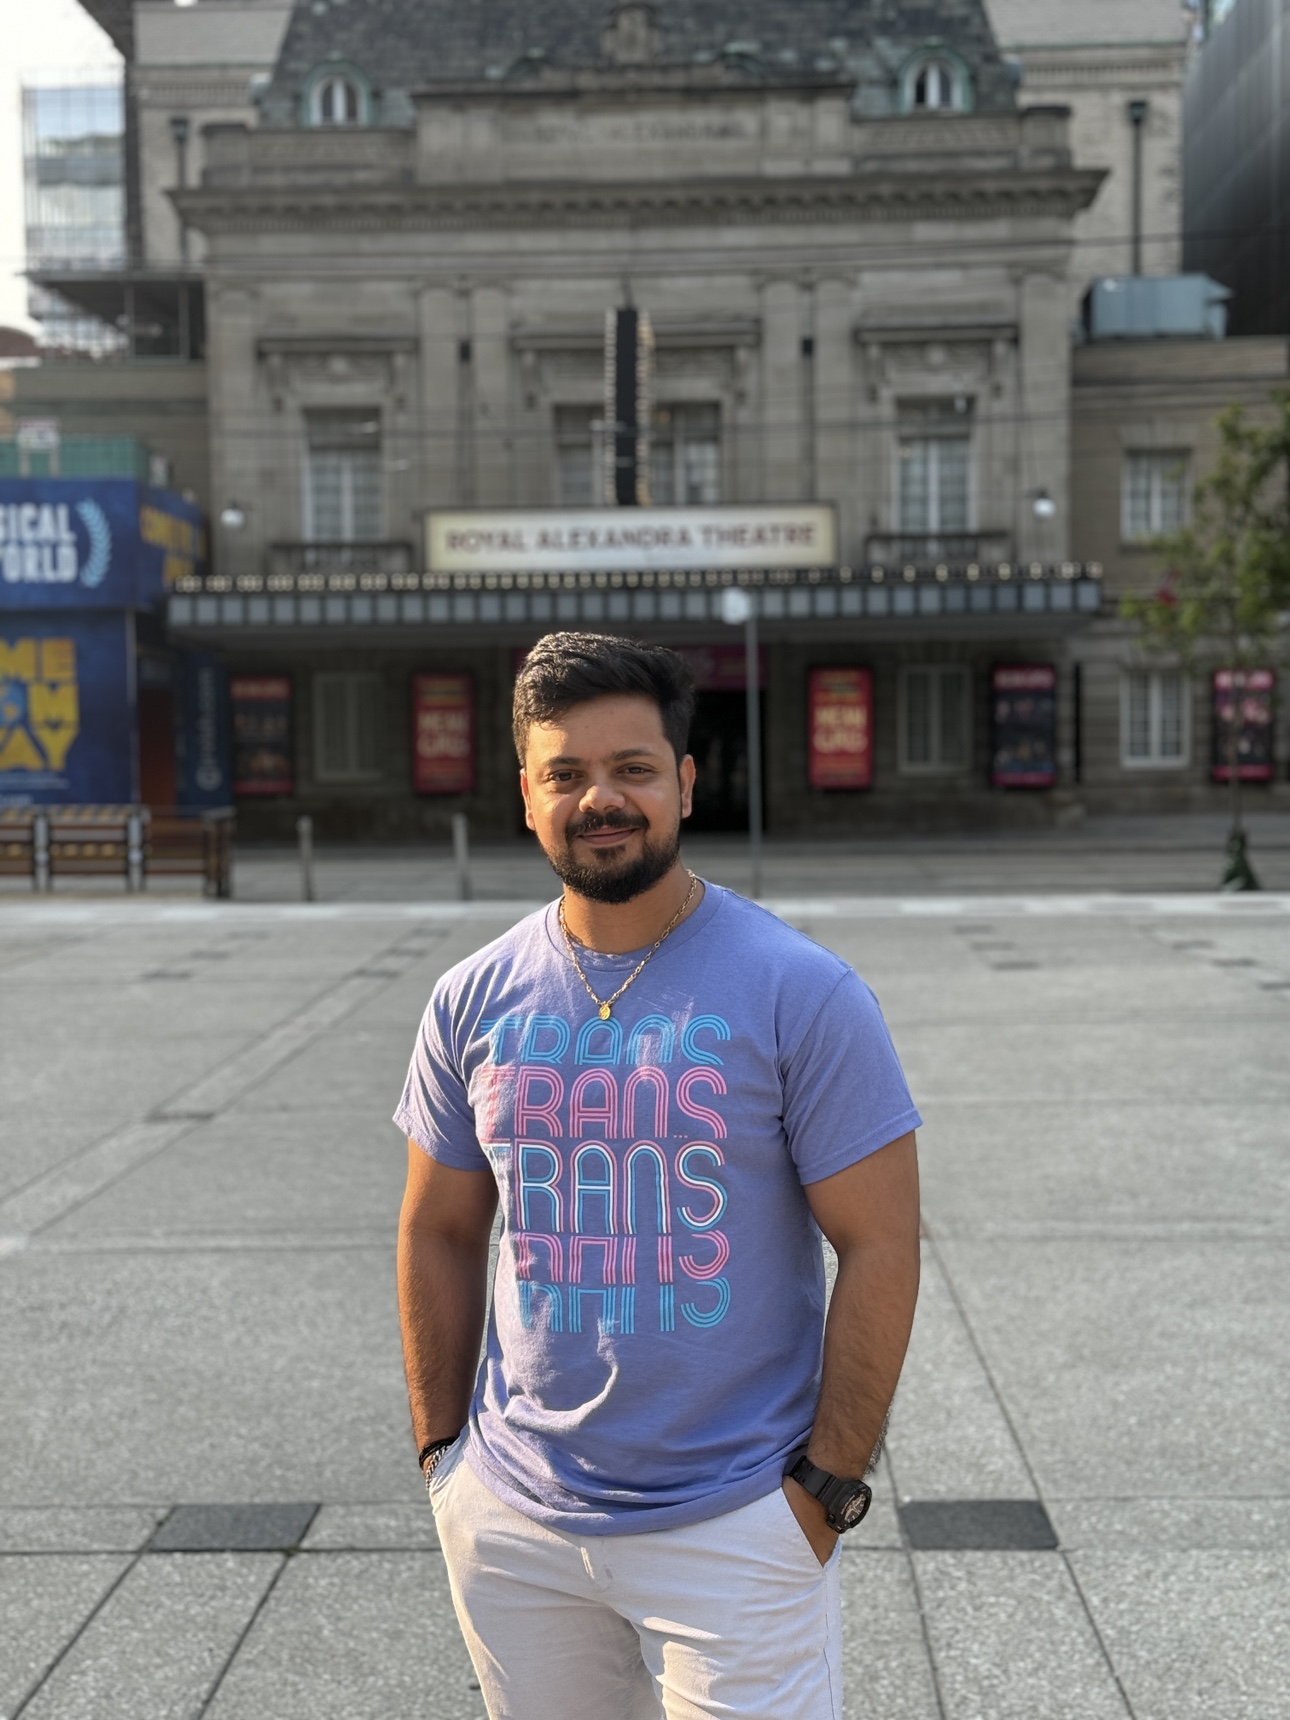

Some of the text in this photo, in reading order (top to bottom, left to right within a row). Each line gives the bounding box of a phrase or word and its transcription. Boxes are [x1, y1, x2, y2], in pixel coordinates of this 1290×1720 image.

[446, 520, 818, 553] ROYAL ALEXANDRA THEATRE
[1, 545, 78, 582] ORLD
[480, 1065, 728, 1139] TRANS
